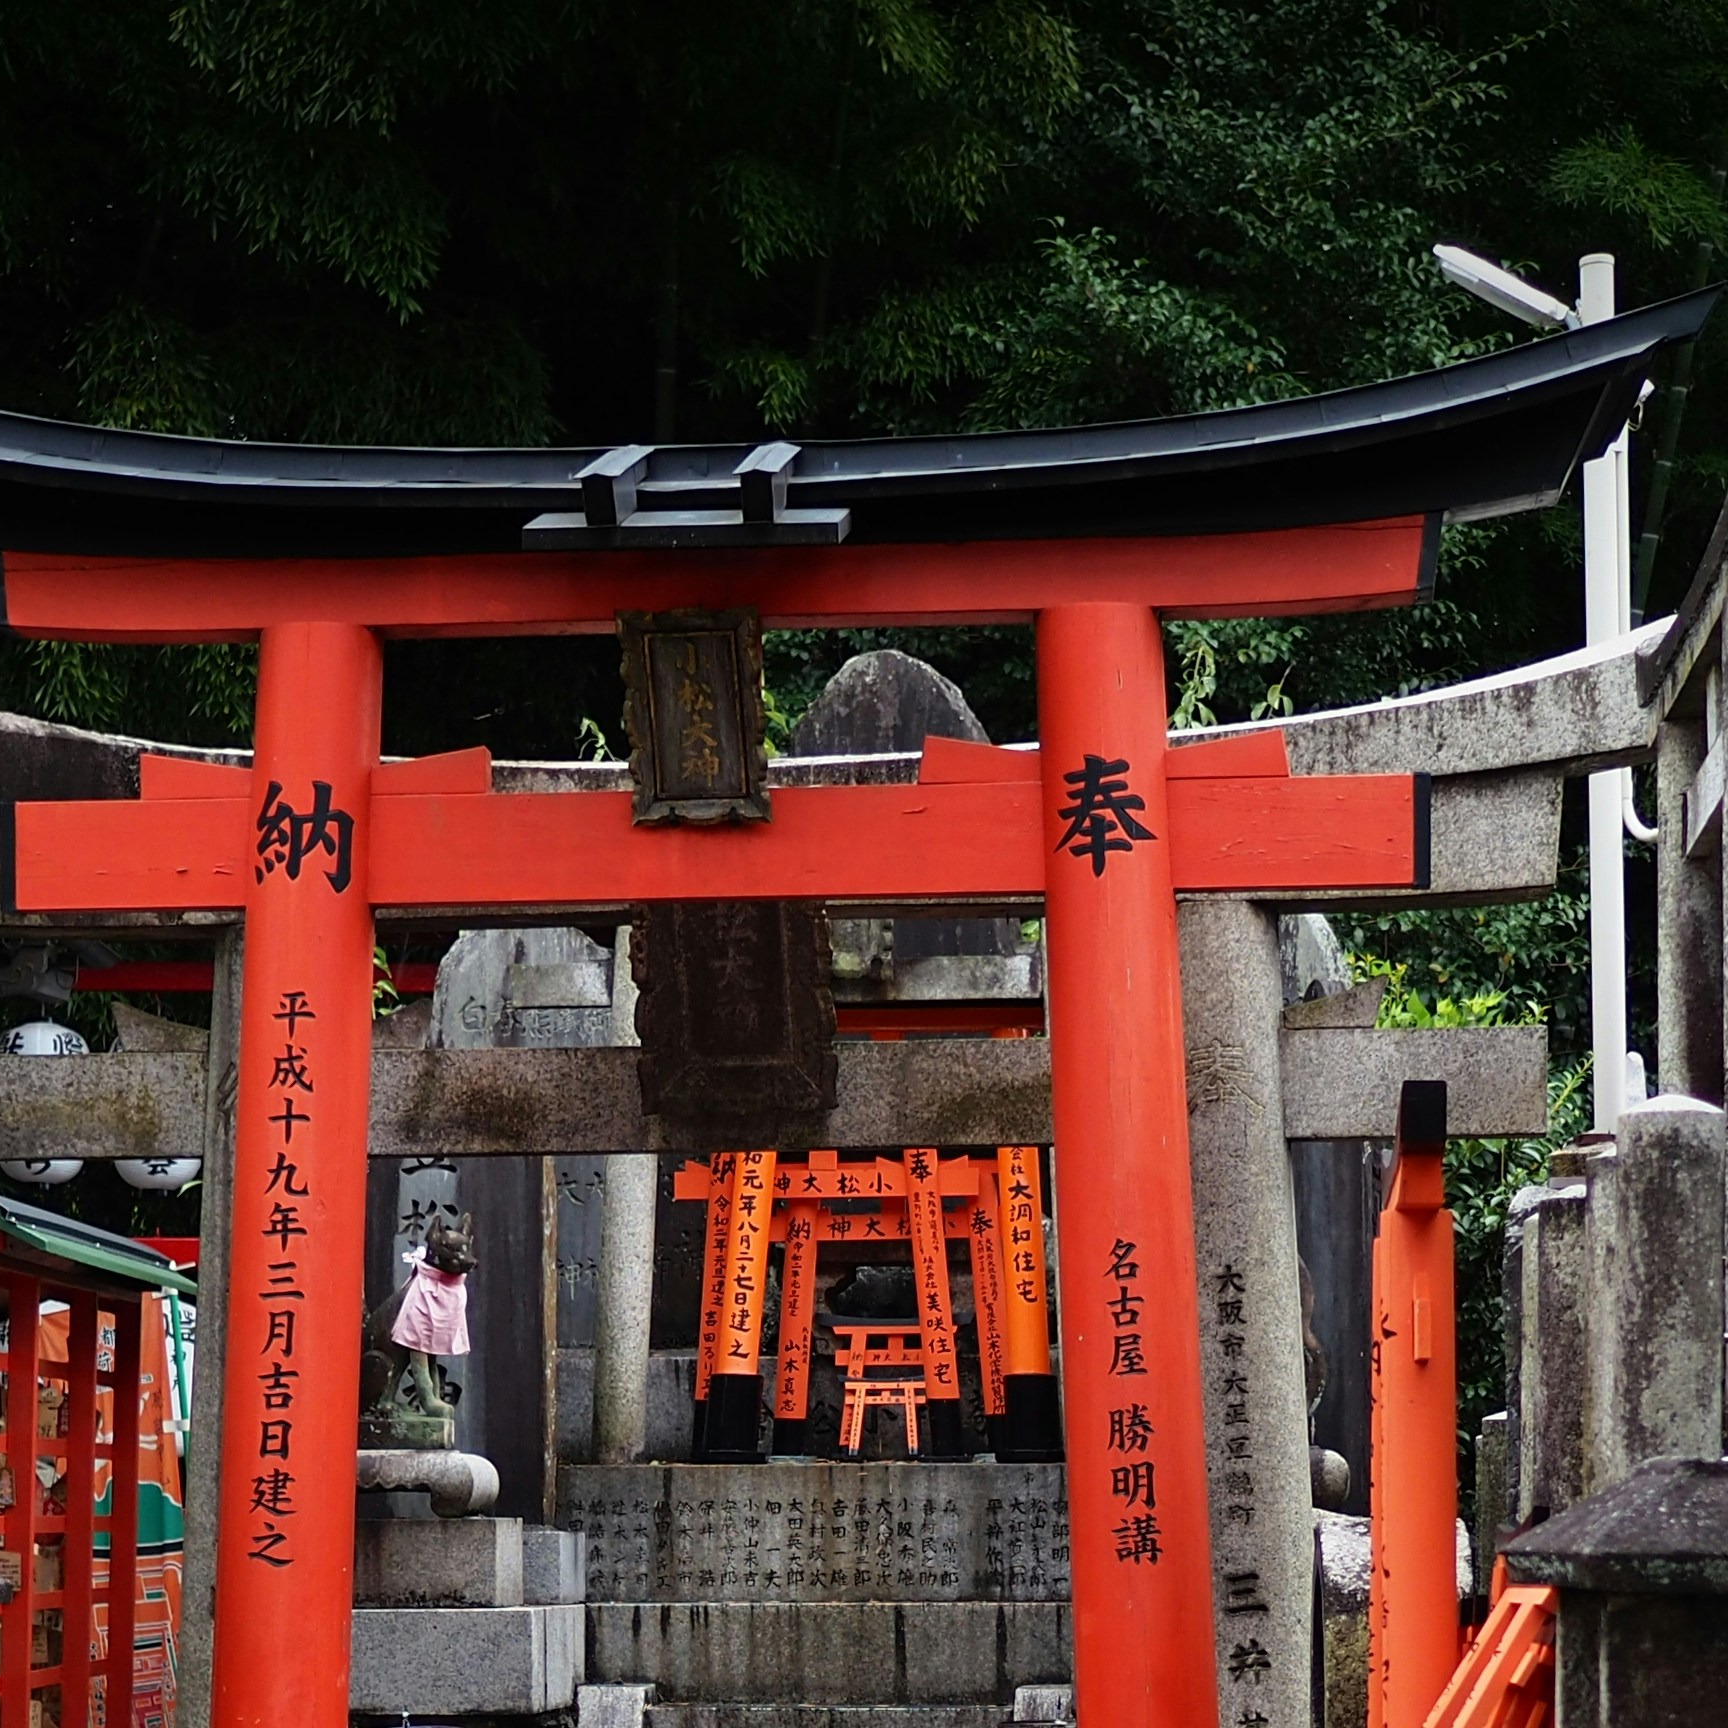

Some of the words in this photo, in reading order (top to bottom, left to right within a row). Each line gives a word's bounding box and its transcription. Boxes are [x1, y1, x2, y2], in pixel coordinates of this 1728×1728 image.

[675, 640, 720, 788] 小松大神
[254, 780, 356, 894] 納
[1053, 755, 1160, 877] 奉
[909, 1149, 933, 1184] 奉
[970, 1207, 994, 1239] 奉
[246, 991, 317, 1568] 平成十九年三月吉日建之
[786, 1216, 812, 1242] 納
[1104, 1237, 1149, 1378] 名古屋
[1107, 1402, 1163, 1566] 勝明講
